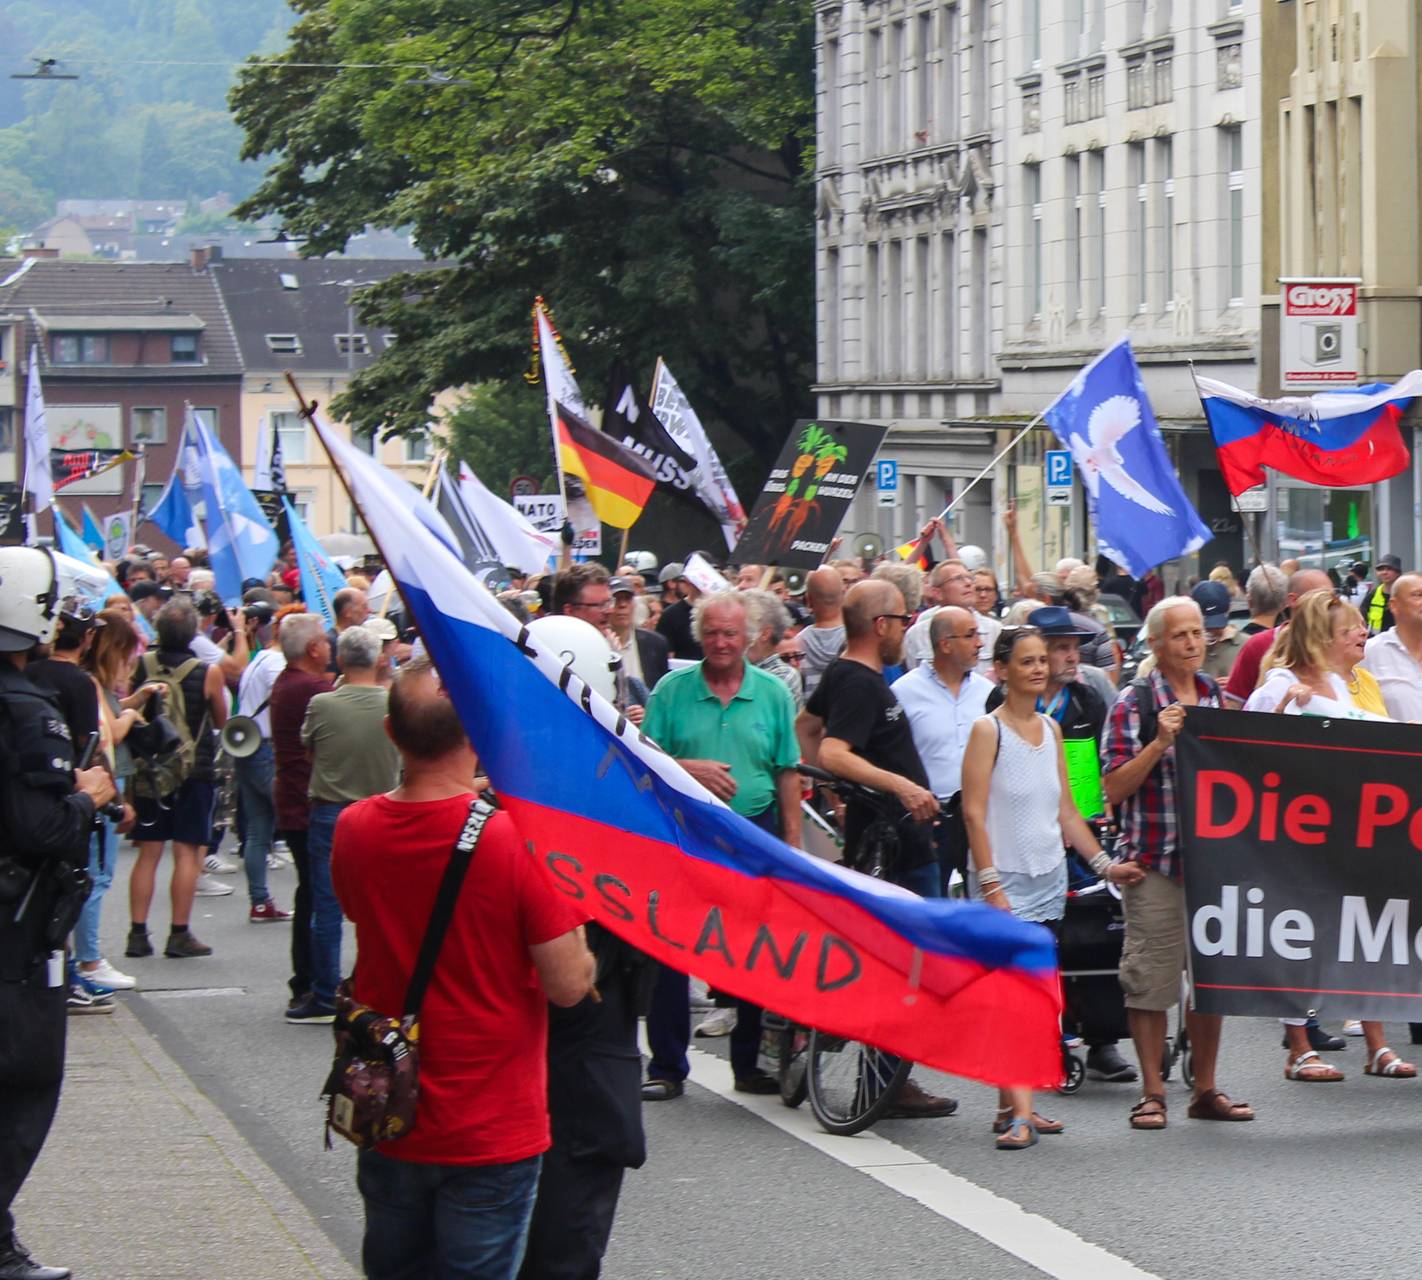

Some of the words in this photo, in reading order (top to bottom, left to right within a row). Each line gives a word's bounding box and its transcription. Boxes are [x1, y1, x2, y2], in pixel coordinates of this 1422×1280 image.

[1289, 286, 1354, 315] Gross
[516, 504, 556, 517] NATO
[1196, 770, 1331, 845] Die
[527, 840, 863, 992] SSLAND
[1191, 885, 1315, 960] die
